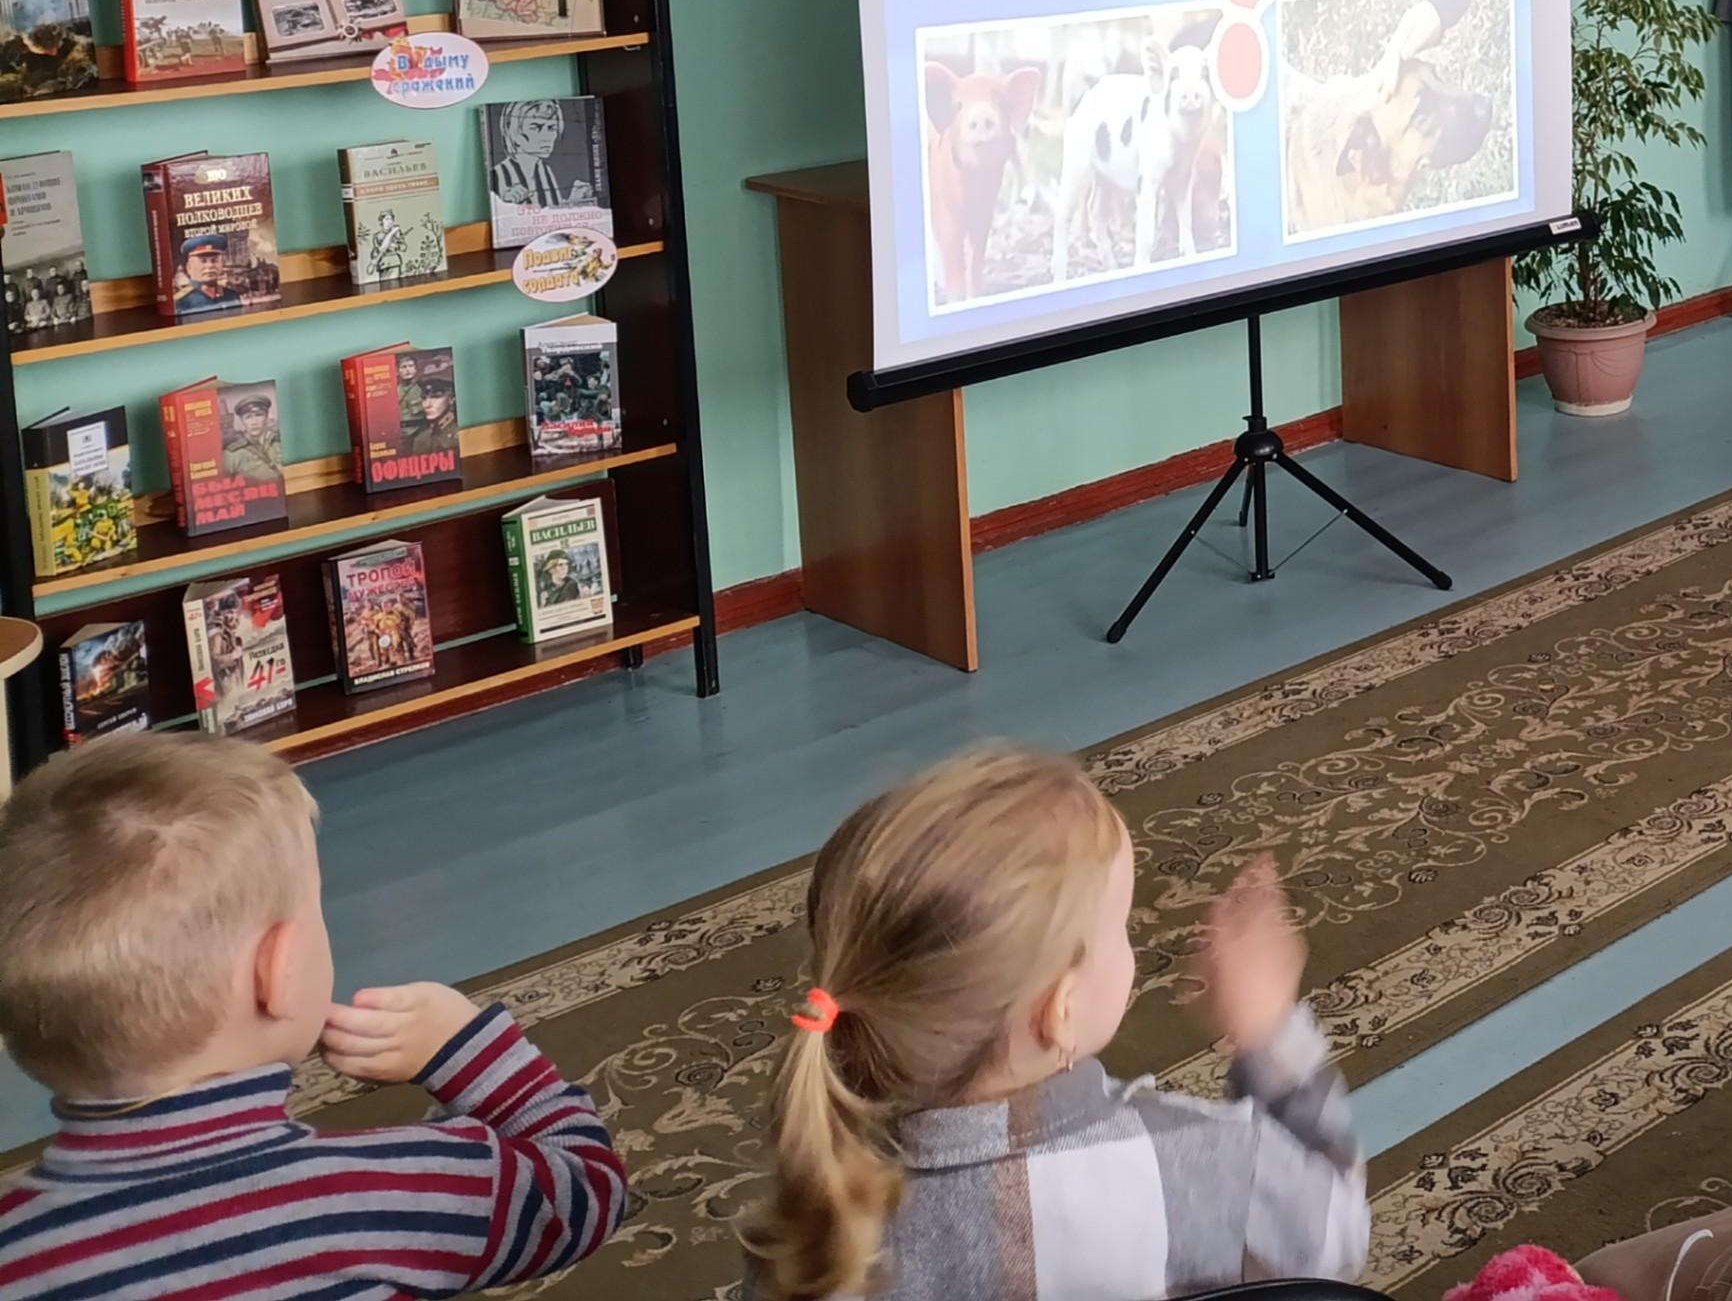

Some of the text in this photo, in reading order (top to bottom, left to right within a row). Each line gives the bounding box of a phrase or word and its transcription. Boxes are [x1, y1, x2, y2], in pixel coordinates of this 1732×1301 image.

[424, 52, 470, 71] дыму
[363, 162, 428, 178] ВАСИЛЬЕВ
[183, 186, 253, 208] ВЕЛИКИХ
[176, 203, 263, 226] ПОЛКОВОДЦЕВ
[371, 450, 455, 483] ОФИЦЕРЫ
[195, 502, 247, 526] МАЙ
[531, 518, 596, 543] ВАСИЛЬЕВ
